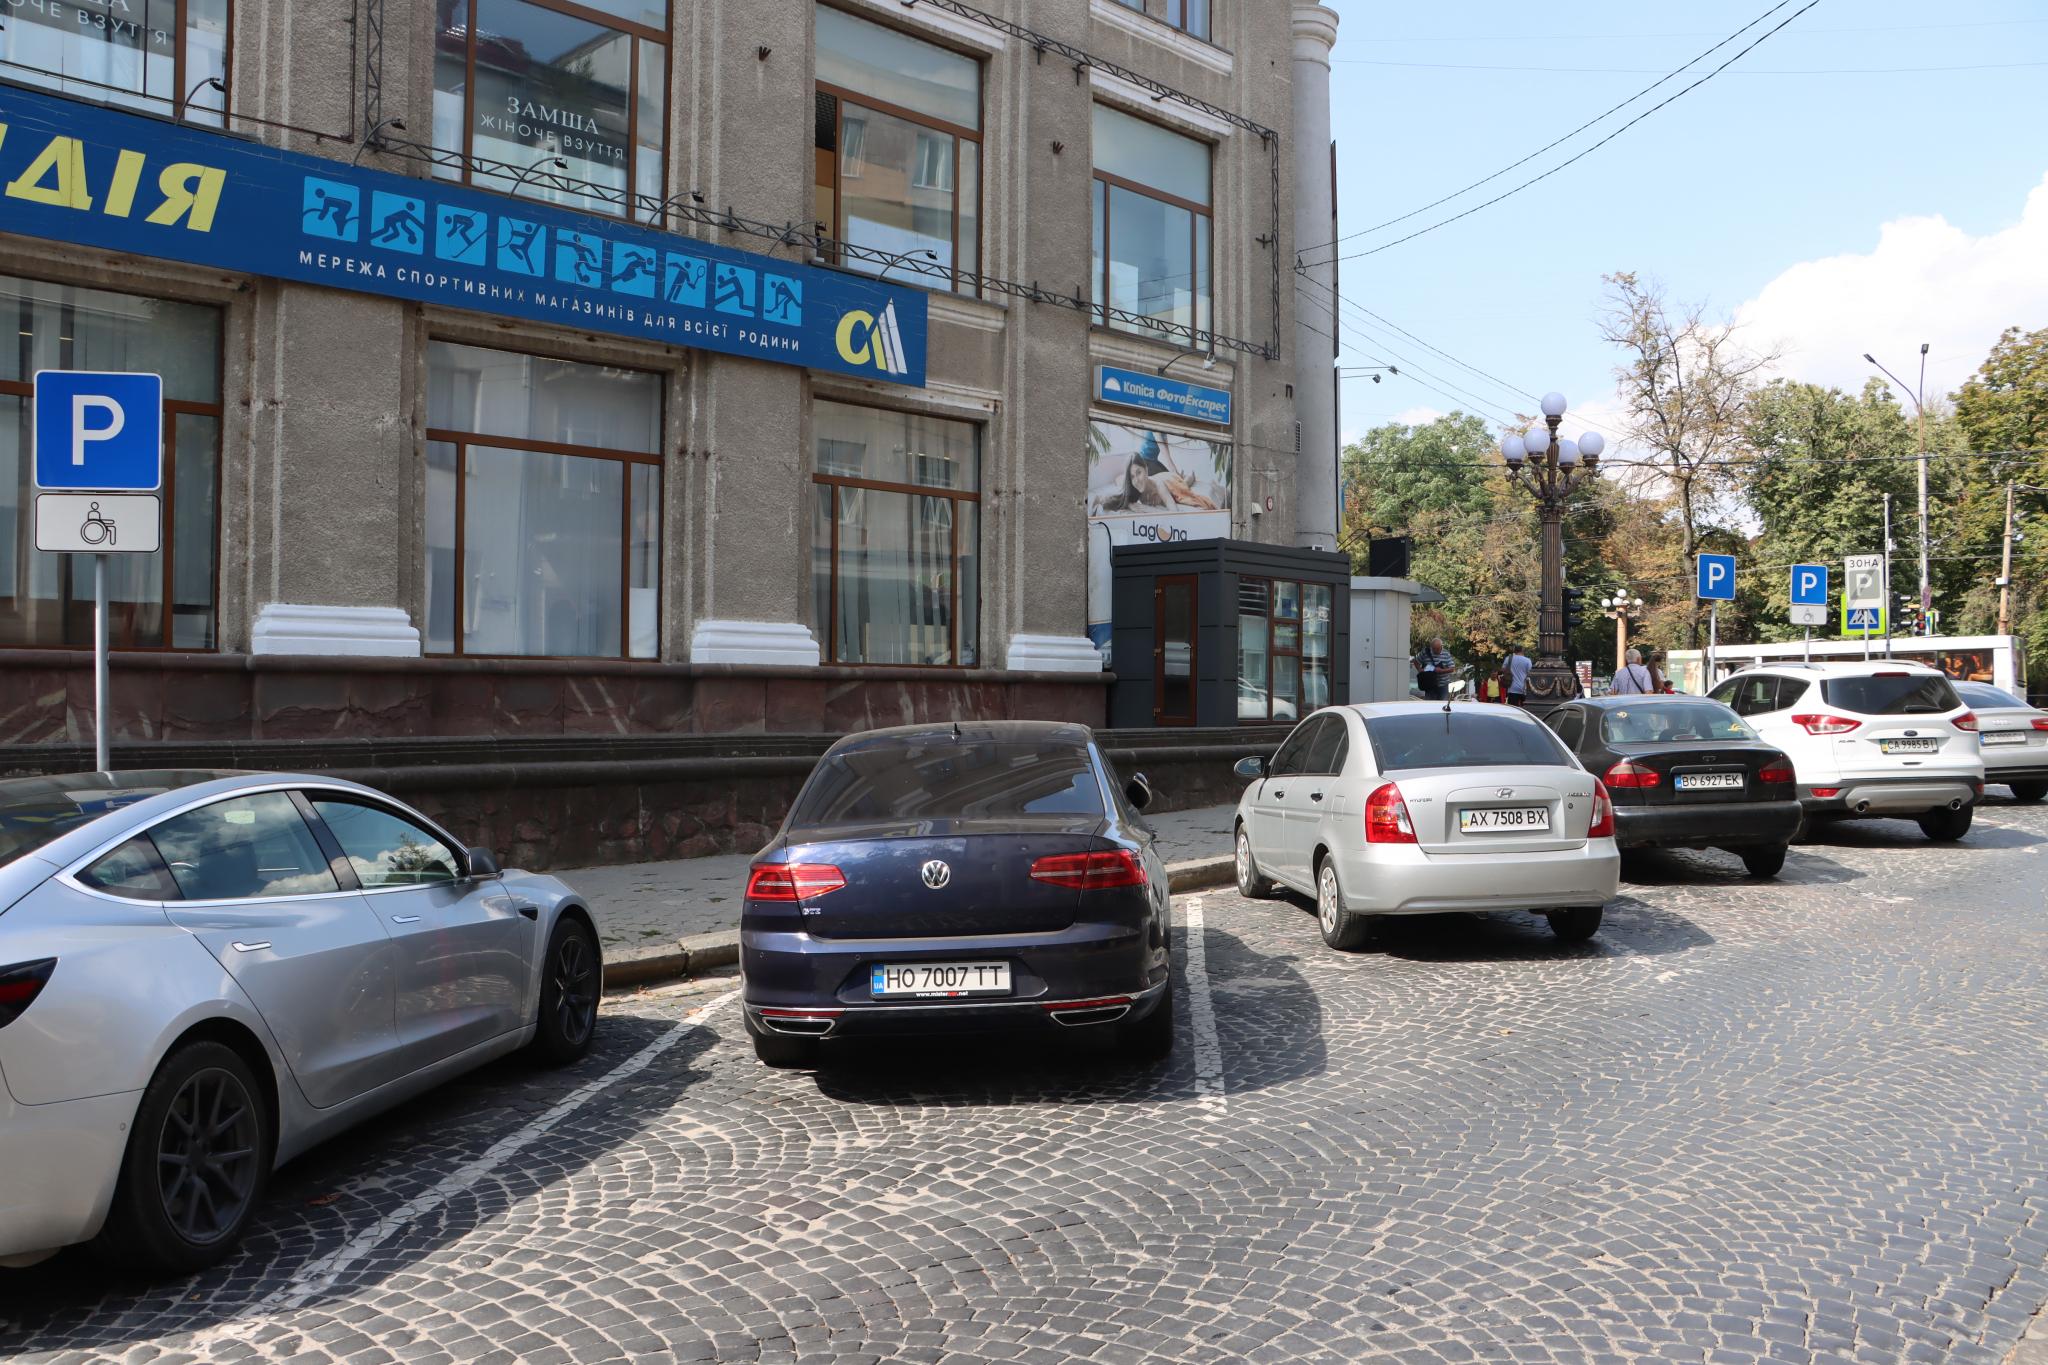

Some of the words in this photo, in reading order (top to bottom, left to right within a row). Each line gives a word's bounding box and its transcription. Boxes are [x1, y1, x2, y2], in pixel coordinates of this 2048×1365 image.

[77, 9, 167, 45] ВЗУТЯ
[507, 96, 598, 135] ЗАМША
[480, 113, 556, 143] ЖІНОЧЕ
[564, 136, 623, 160] ВЗУТТЯ
[0, 123, 227, 233] ДІЯ
[300, 251, 386, 279] МЕРЕЖА
[397, 268, 524, 302] СПОРТИВНИХ
[644, 313, 675, 329] ДЛЯ
[740, 329, 799, 352] РОДИНИ
[1123, 381, 1154, 399] Konica
[72, 394, 125, 466] P
[1708, 562, 1726, 590] P
[1849, 558, 1879, 568] ЗОНА
[1801, 572, 1818, 597] P
[1700, 775, 1722, 786] 6927
[1725, 774, 1740, 785] EK
[1470, 812, 1488, 826] AX
[1492, 811, 1523, 825] 7508
[1527, 810, 1546, 824] BX
[886, 968, 915, 988] HO
[921, 966, 969, 988] 7007
[974, 965, 1003, 986] TT
